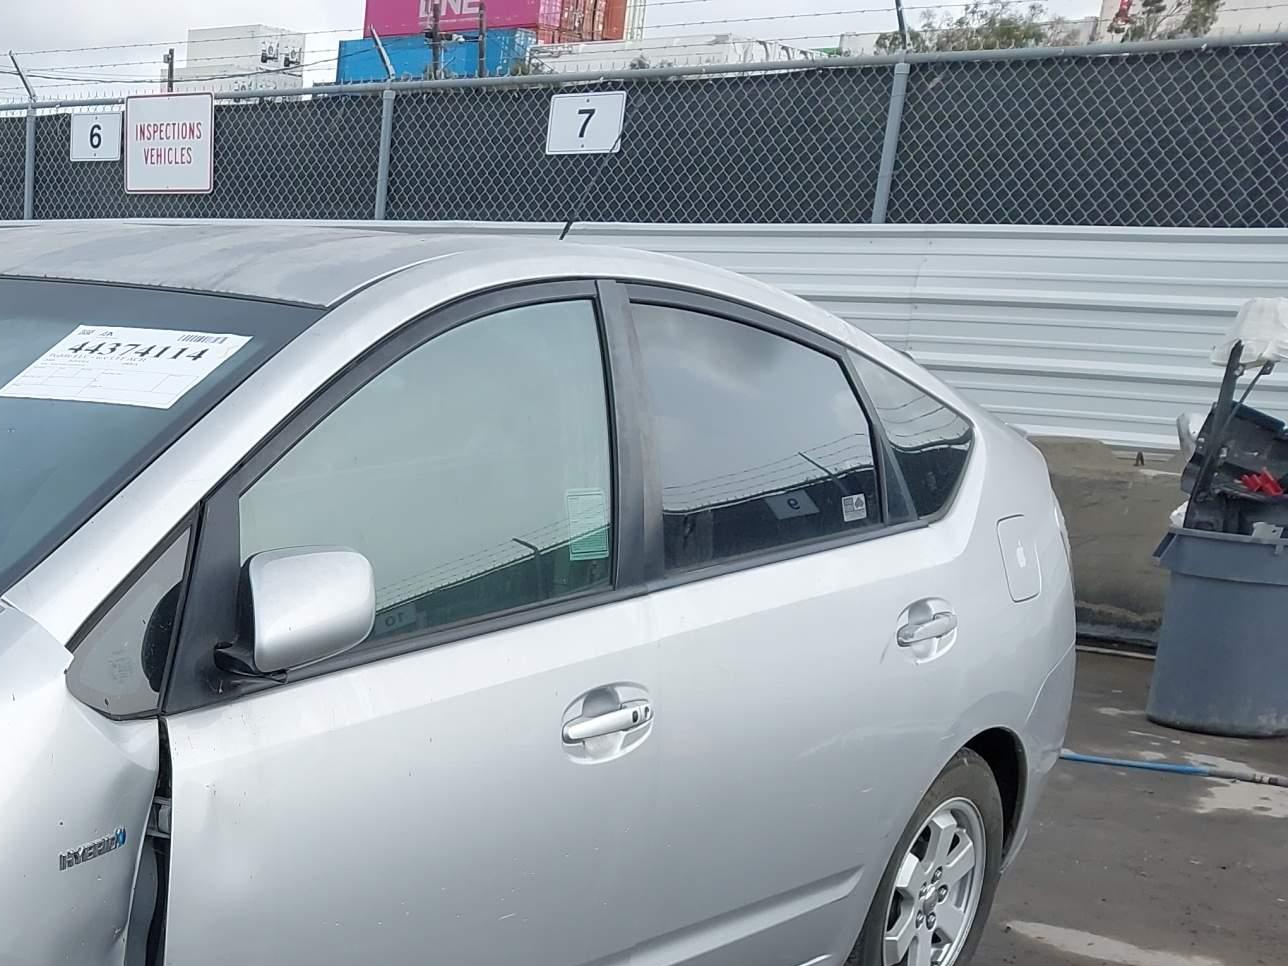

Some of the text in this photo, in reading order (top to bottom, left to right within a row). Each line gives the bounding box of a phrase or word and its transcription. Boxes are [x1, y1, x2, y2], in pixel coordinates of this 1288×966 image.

[135, 121, 202, 141] INSPECTIONS
[577, 108, 596, 138] 7
[89, 124, 102, 149] 6
[143, 147, 193, 166] VEHICLES
[68, 341, 209, 361] 44374114
